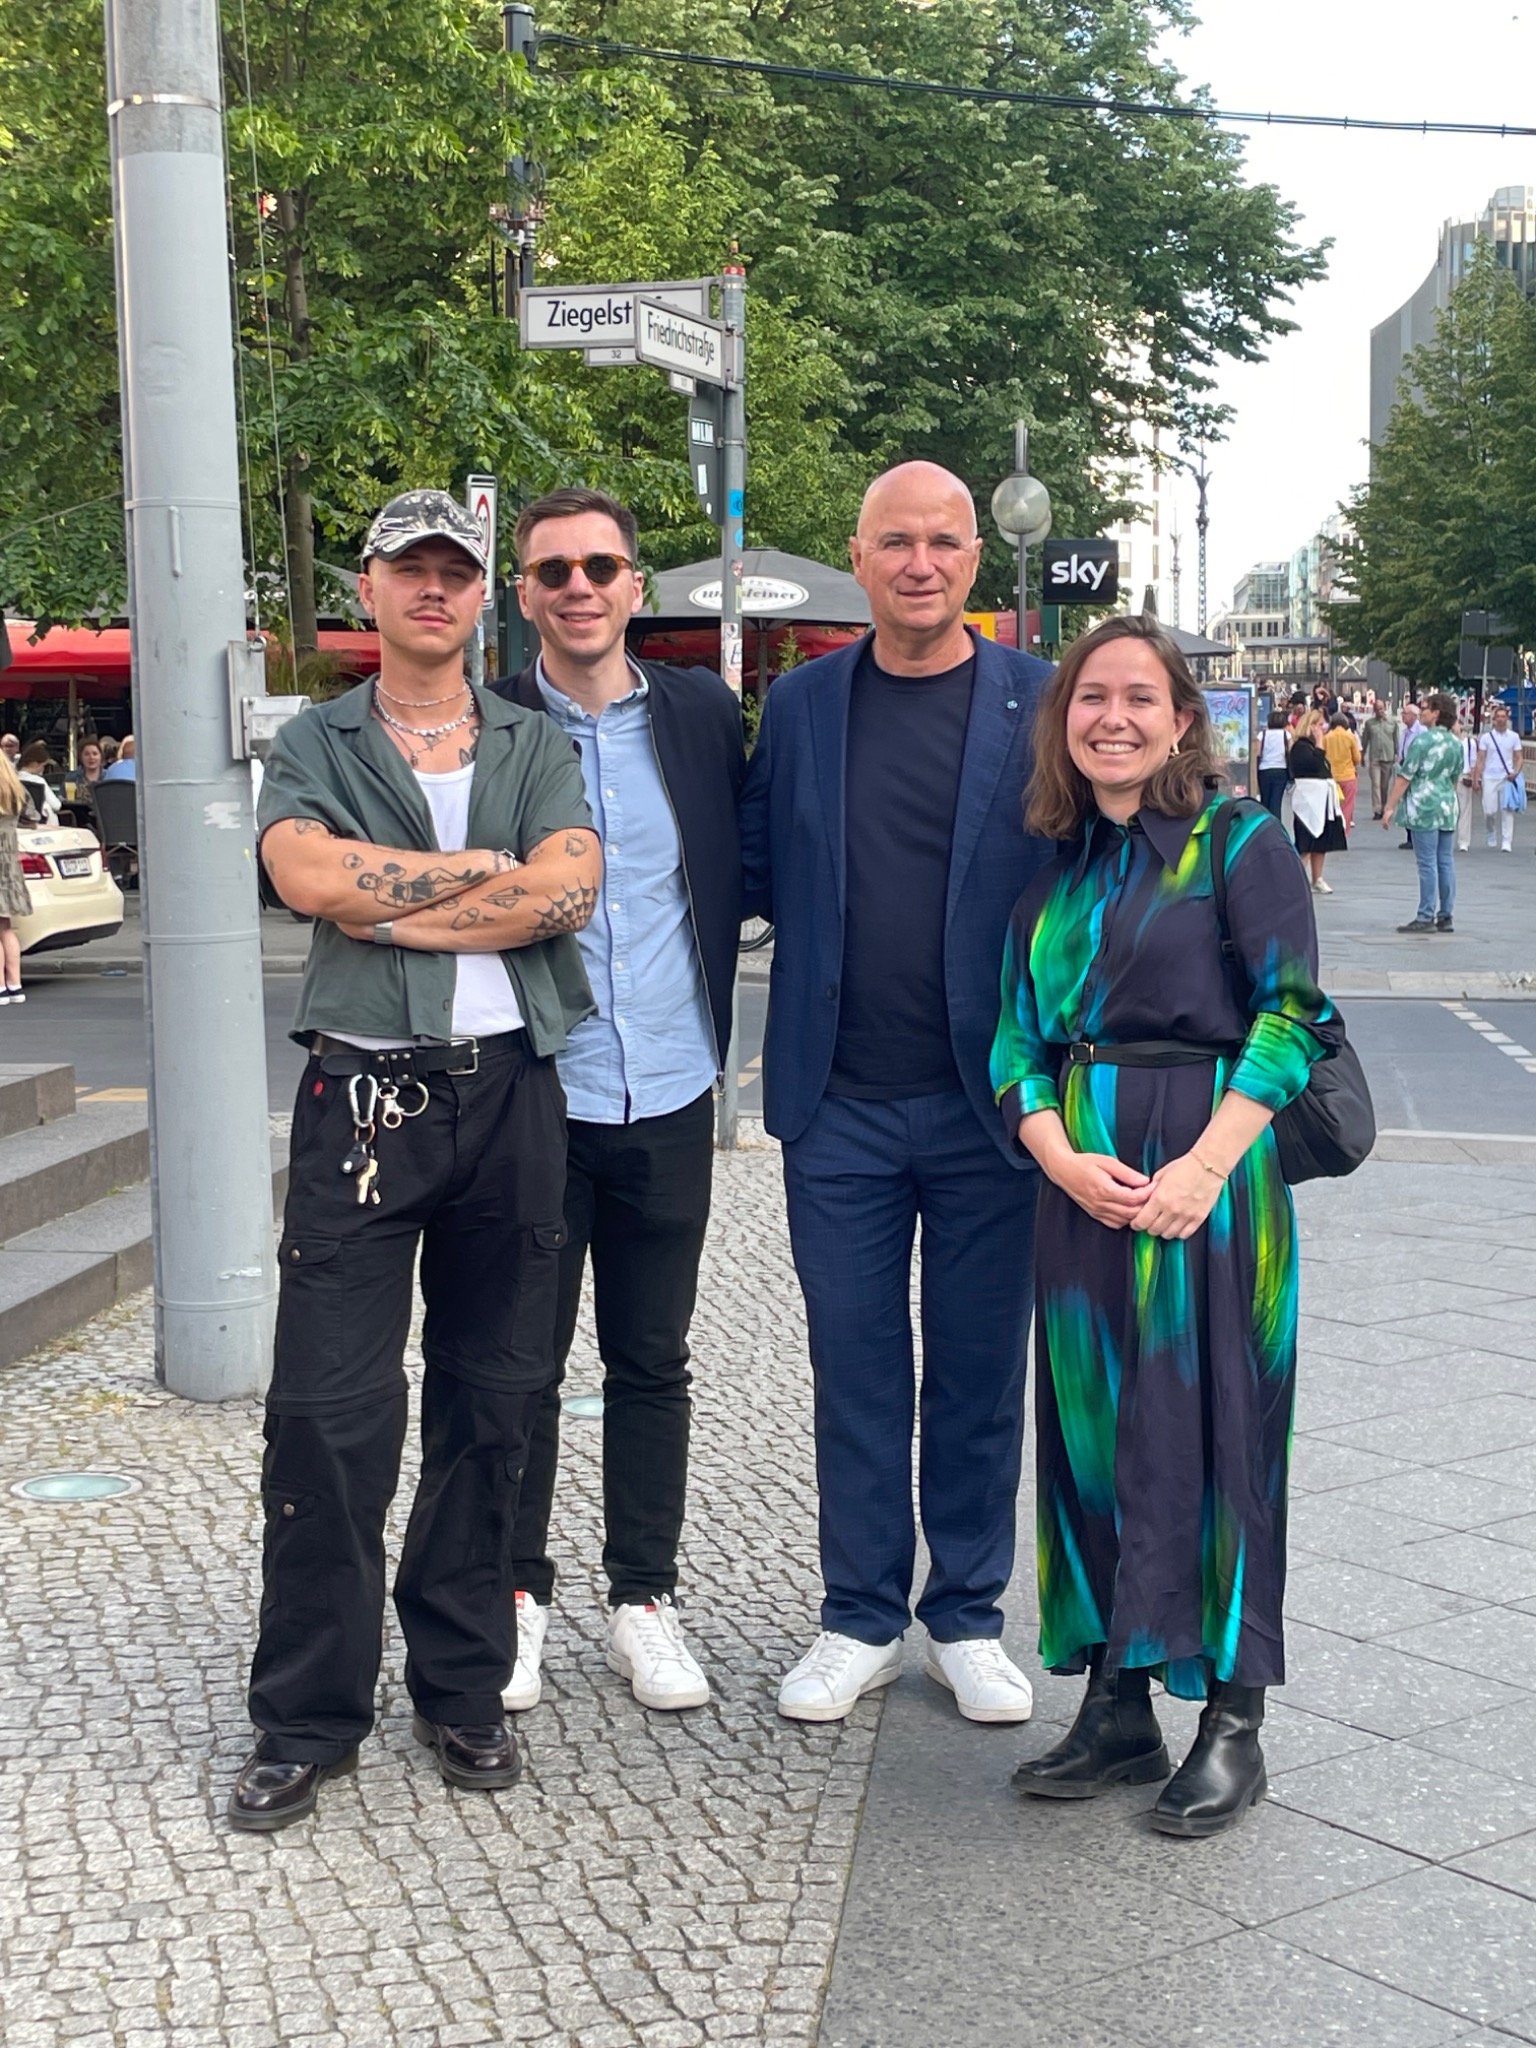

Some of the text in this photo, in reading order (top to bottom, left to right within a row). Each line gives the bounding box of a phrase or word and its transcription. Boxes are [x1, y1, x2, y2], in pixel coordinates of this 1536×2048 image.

[547, 299, 632, 332] Ziegelst
[611, 349, 622, 359] 32
[647, 311, 714, 365] Friedrichstraße
[1051, 553, 1109, 590] sky
